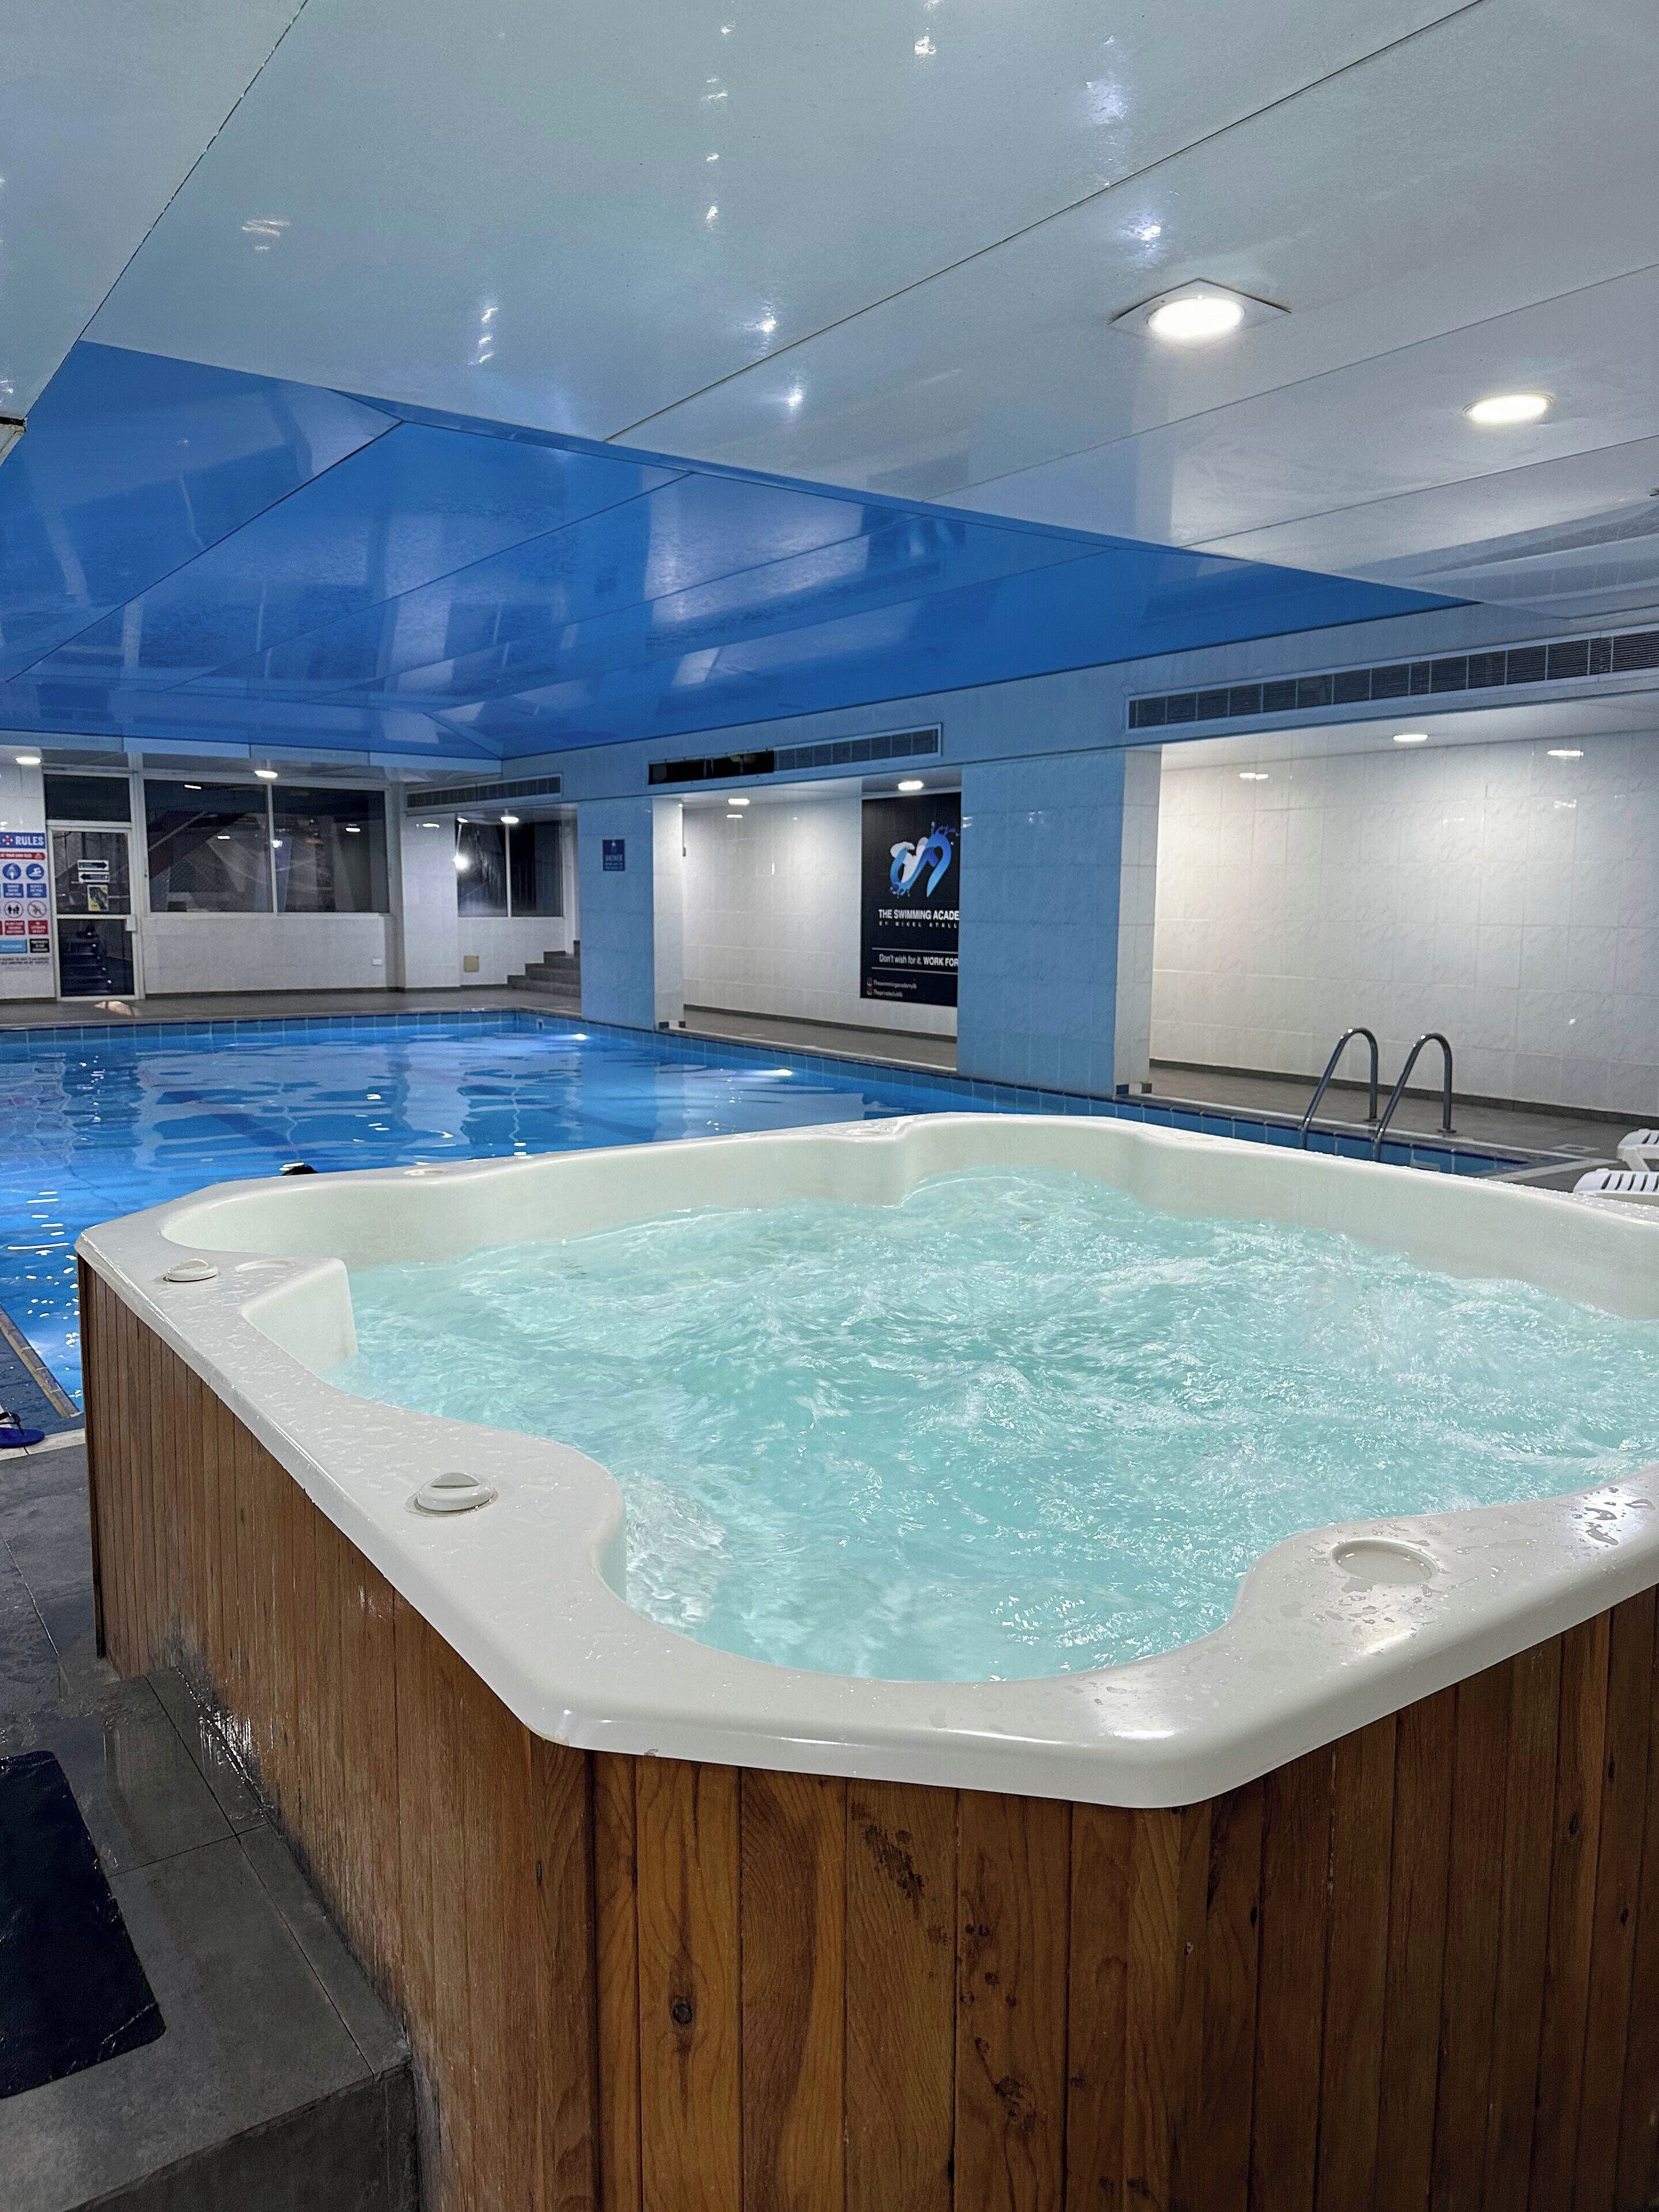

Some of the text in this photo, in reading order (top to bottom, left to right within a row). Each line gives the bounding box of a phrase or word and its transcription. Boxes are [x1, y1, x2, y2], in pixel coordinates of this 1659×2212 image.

[16, 836, 44, 846] RULES
[878, 909, 959, 921] THE SWIMMING ACADE
[879, 953, 894, 963] Don't
[895, 955, 907, 964] wish
[908, 955, 916, 964] for
[923, 956, 944, 967] WORK
[945, 957, 959, 967] FOR
